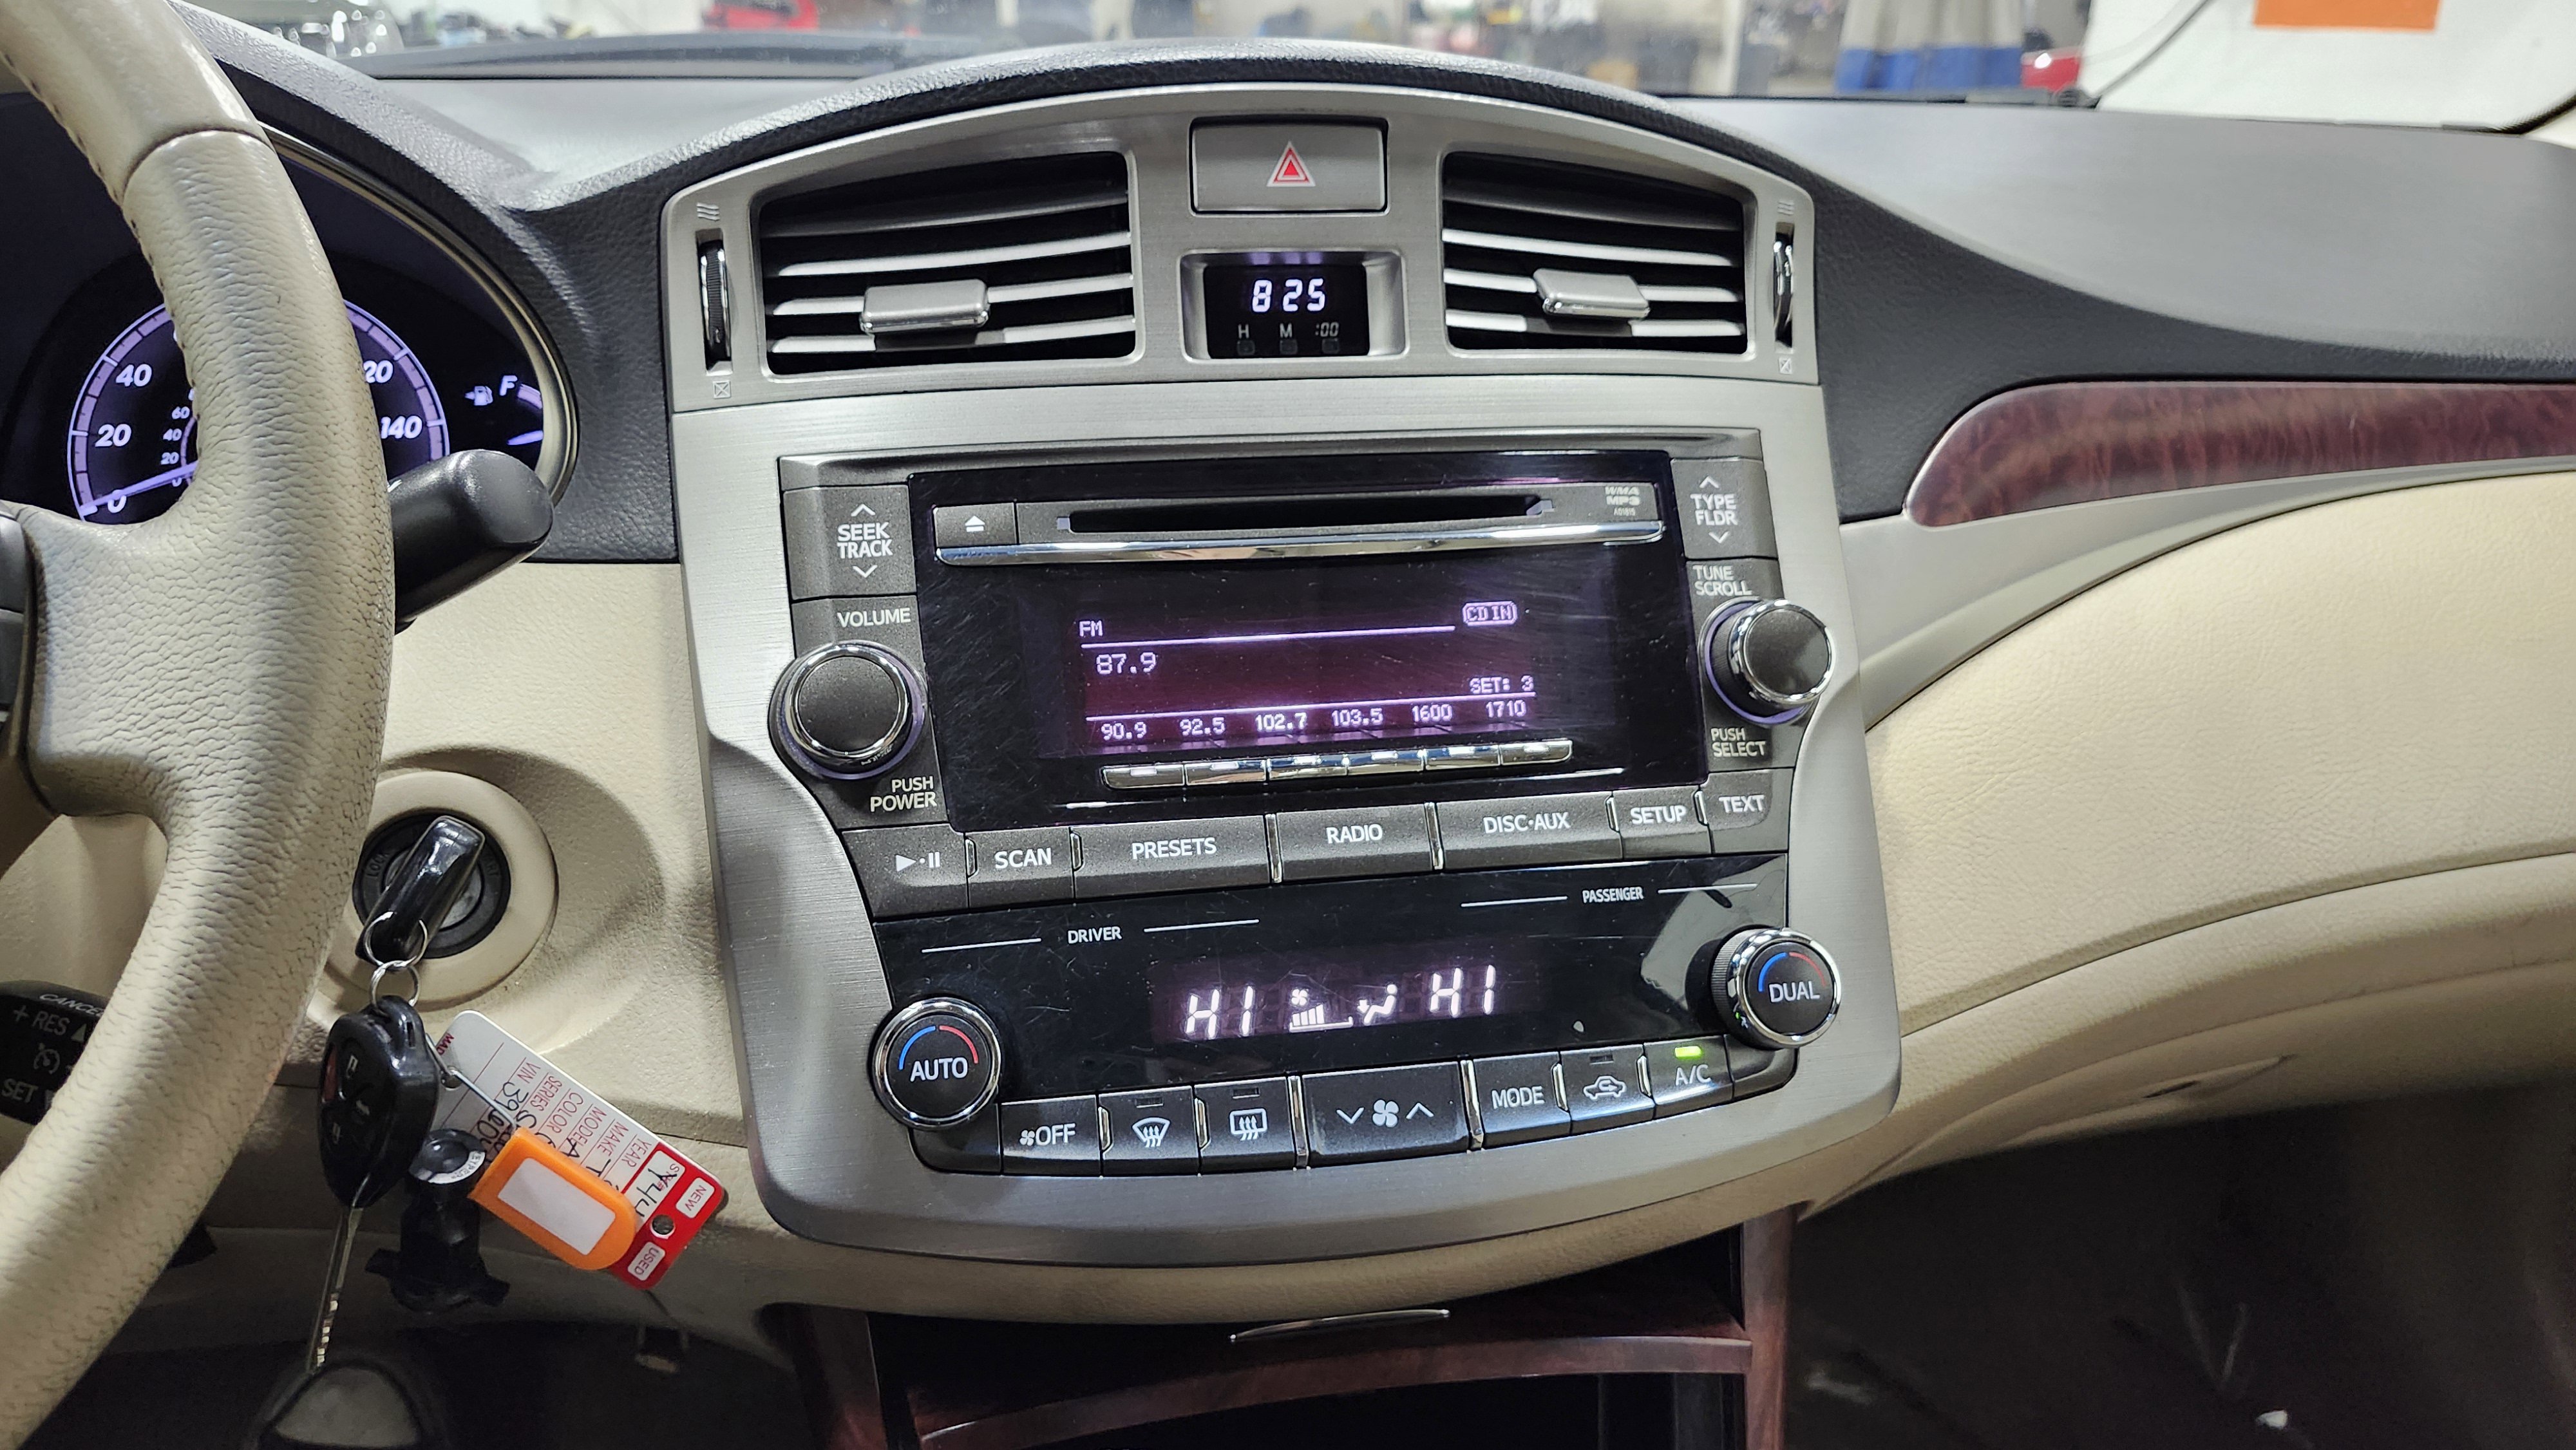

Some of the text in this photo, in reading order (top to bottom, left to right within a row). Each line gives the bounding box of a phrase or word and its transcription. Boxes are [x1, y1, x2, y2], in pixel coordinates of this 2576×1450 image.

[1238, 324, 1249, 339] H
[1280, 323, 1293, 339] M
[115, 364, 152, 386] 40
[363, 361, 393, 383] 20
[500, 375, 518, 397] F
[172, 406, 190, 419] 60
[95, 424, 131, 447] 20
[163, 428, 182, 441] 40
[381, 416, 422, 439] 140
[160, 452, 179, 465] 20
[1605, 485, 1640, 495] WMA
[1606, 495, 1641, 505] MP3
[1690, 493, 1738, 511] TYPE
[1694, 509, 1738, 526] FLDR
[837, 522, 891, 542] SEEK
[837, 539, 893, 560] TRACK
[1692, 565, 1735, 581] TUNE
[1694, 580, 1753, 597] SCROLL
[837, 607, 911, 628] VOLUME
[1466, 603, 1513, 622] CD IN
[1079, 620, 1103, 637] FM
[1095, 652, 1157, 675] 87.9
[1470, 675, 1535, 695] SET: 3
[1101, 699, 1527, 740] 90.9 92.5 102.7 103.5 1600 1710
[1710, 728, 1746, 741] PUSH
[1712, 740, 1766, 758] SELECT
[891, 776, 934, 793] PUSH
[870, 791, 937, 813] POWER
[1718, 795, 1765, 813] TEXT
[1630, 804, 1687, 825] SETUP
[1325, 824, 1383, 844] RADIO
[994, 847, 1052, 870] SCAN
[1131, 836, 1218, 860] PRESETS
[1582, 886, 1644, 904] PASSENGER
[1067, 926, 1122, 945] DRIVER
[1768, 981, 1821, 1004] DUAL
[39, 993, 104, 1017] CANCE
[32, 1010, 71, 1037] RES
[516, 1062, 542, 1084] VIN
[909, 1057, 968, 1082] AUTO
[1674, 1064, 1712, 1086] A/C
[1, 1077, 38, 1104] SET
[530, 1075, 563, 1111] SERIES
[1491, 1085, 1546, 1111] MODE
[546, 1091, 584, 1133] COLOR
[597, 1120, 629, 1156] MAKE
[1034, 1122, 1076, 1146] OFF
[621, 1138, 652, 1168] YEAR
[685, 1185, 707, 1212] NEW
[634, 1247, 659, 1276] USED
